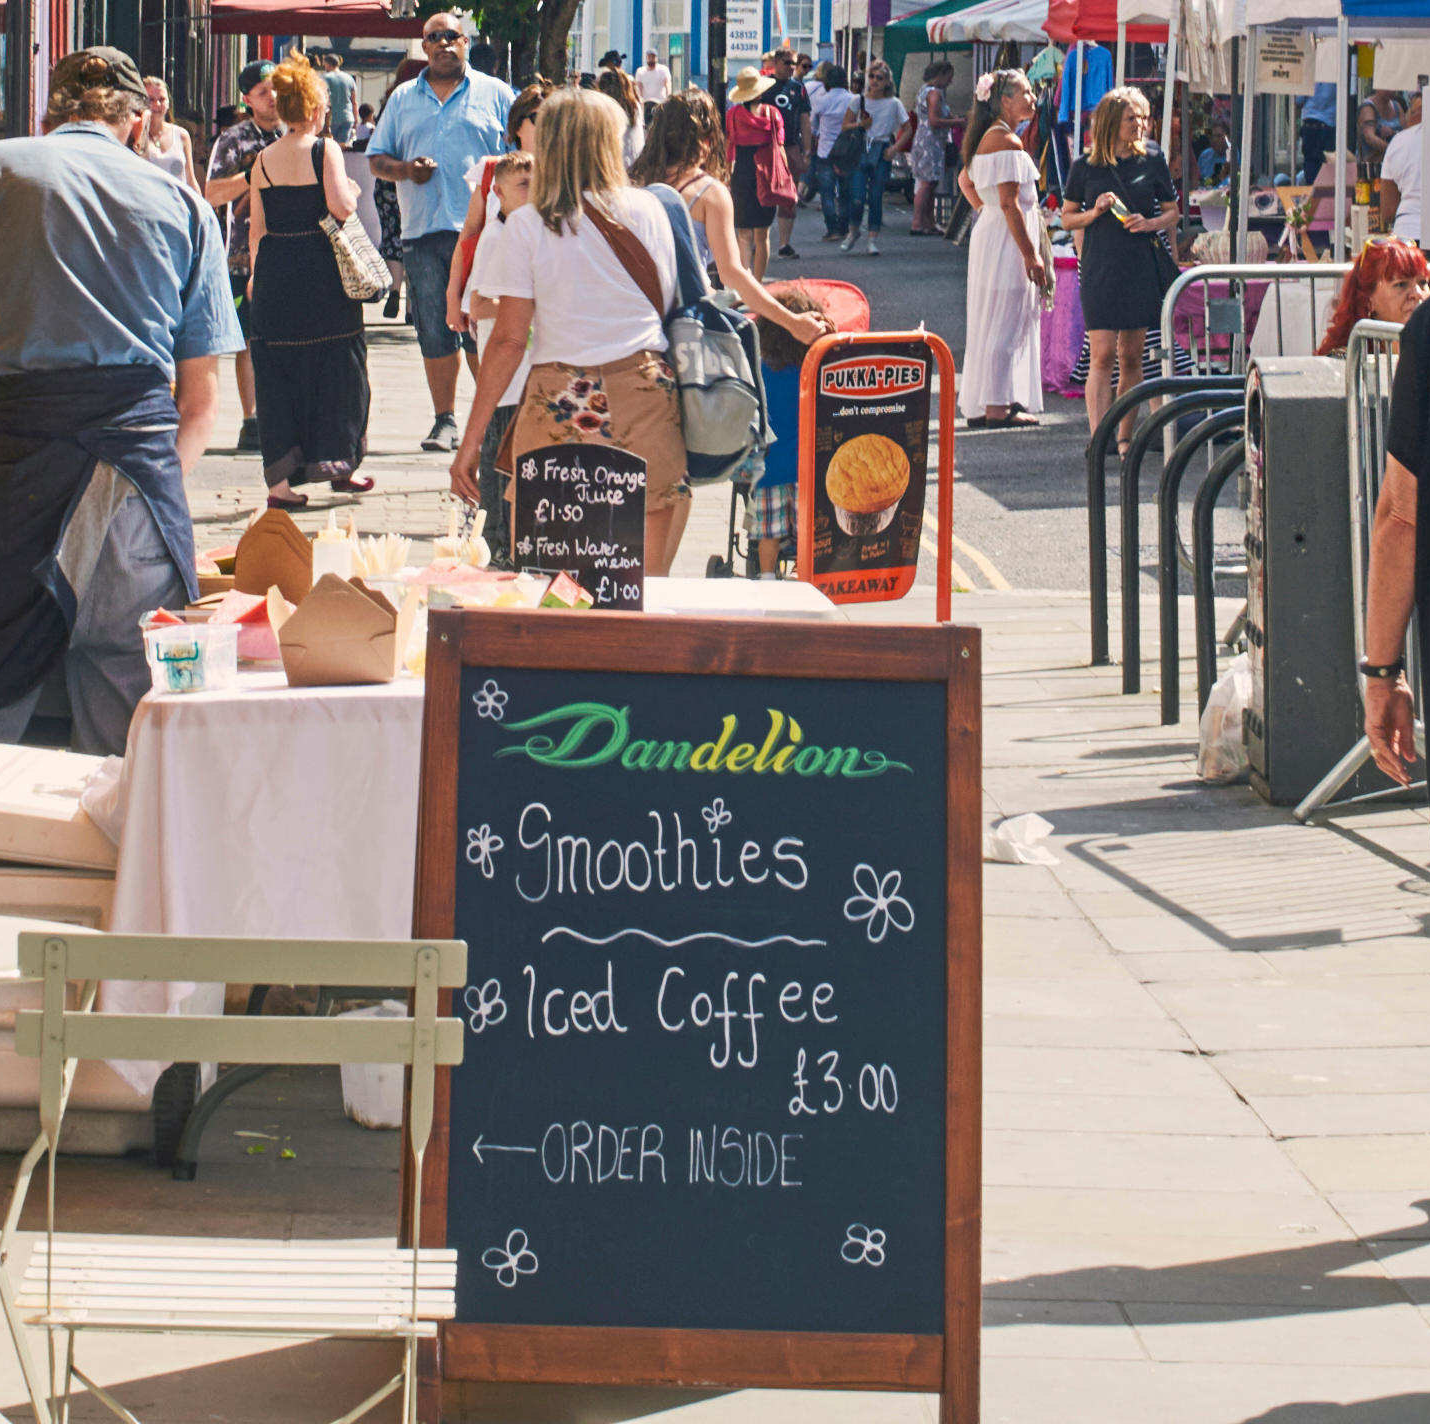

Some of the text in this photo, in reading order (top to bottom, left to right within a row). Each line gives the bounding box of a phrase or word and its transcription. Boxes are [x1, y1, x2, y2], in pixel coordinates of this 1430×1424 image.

[860, 403, 906, 416] compromise
[544, 458, 647, 493] Fresh Orange
[575, 483, 625, 505] Juice
[536, 536, 570, 557] Fresh
[818, 576, 900, 596] TAKEAWAY
[495, 701, 913, 778] Dandelion
[523, 961, 838, 1072] Iced Coffee
[542, 1121, 803, 1187] ORDER INSIDE
